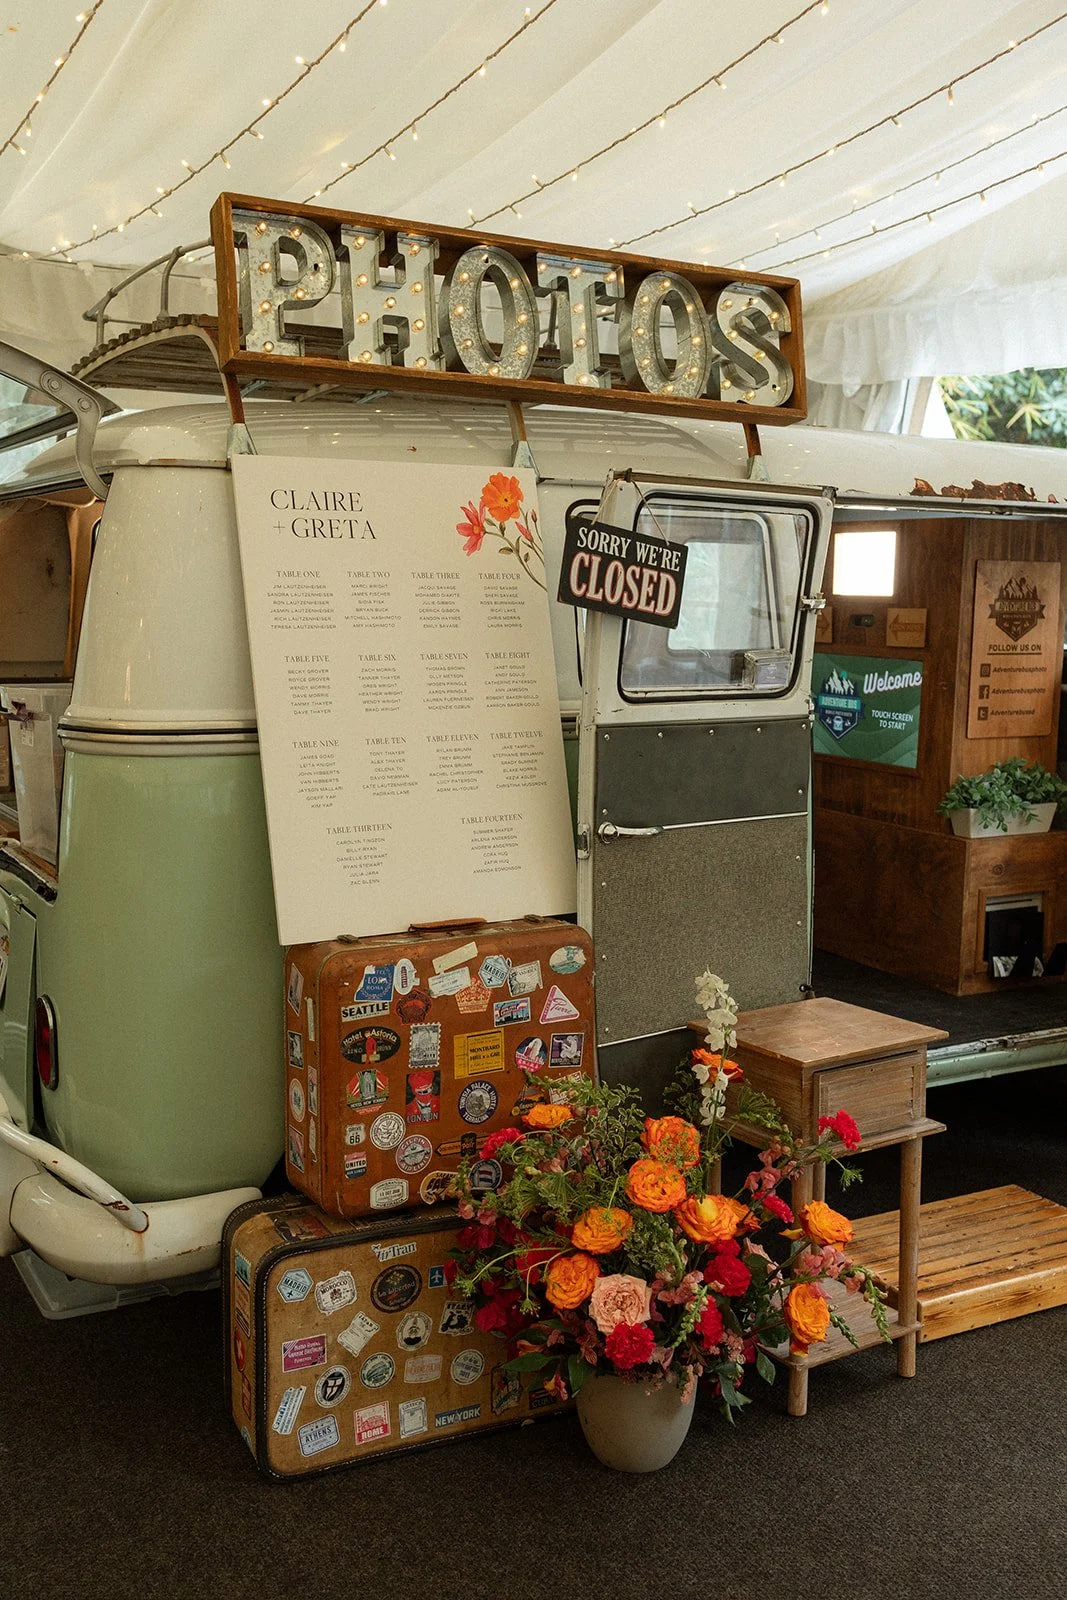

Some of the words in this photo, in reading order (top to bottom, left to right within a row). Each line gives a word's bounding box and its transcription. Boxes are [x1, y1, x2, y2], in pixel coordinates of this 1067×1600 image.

[231, 207, 794, 408] PHOTOS
[270, 489, 363, 512] CLAIRE
[291, 517, 376, 540] GRETA
[576, 527, 631, 559] SORRY
[635, 541, 681, 572] WE'RE
[570, 551, 676, 617] CLOSED
[863, 671, 922, 694] Welcome
[872, 710, 891, 719] TOUCH
[892, 713, 914, 722] SCREEN
[880, 720, 888, 728] TO
[888, 721, 906, 730] START
[485, 813, 522, 822] FOURTEEN
[353, 823, 392, 832] THIRTEEN
[484, 964, 504, 979] MADRID
[342, 1002, 388, 1018] SEATTLE
[343, 1032, 362, 1046] Hotel
[370, 1028, 397, 1042] Astoria
[350, 1135, 360, 1144] 66
[346, 1160, 366, 1168] UNITED
[284, 1279, 307, 1292] MADRID
[320, 1280, 348, 1294] MOROCCO
[436, 1414, 455, 1428] NEW
[456, 1408, 480, 1422] YORK
[305, 1426, 332, 1442] ATHENS
[362, 1426, 384, 1440] ROME
